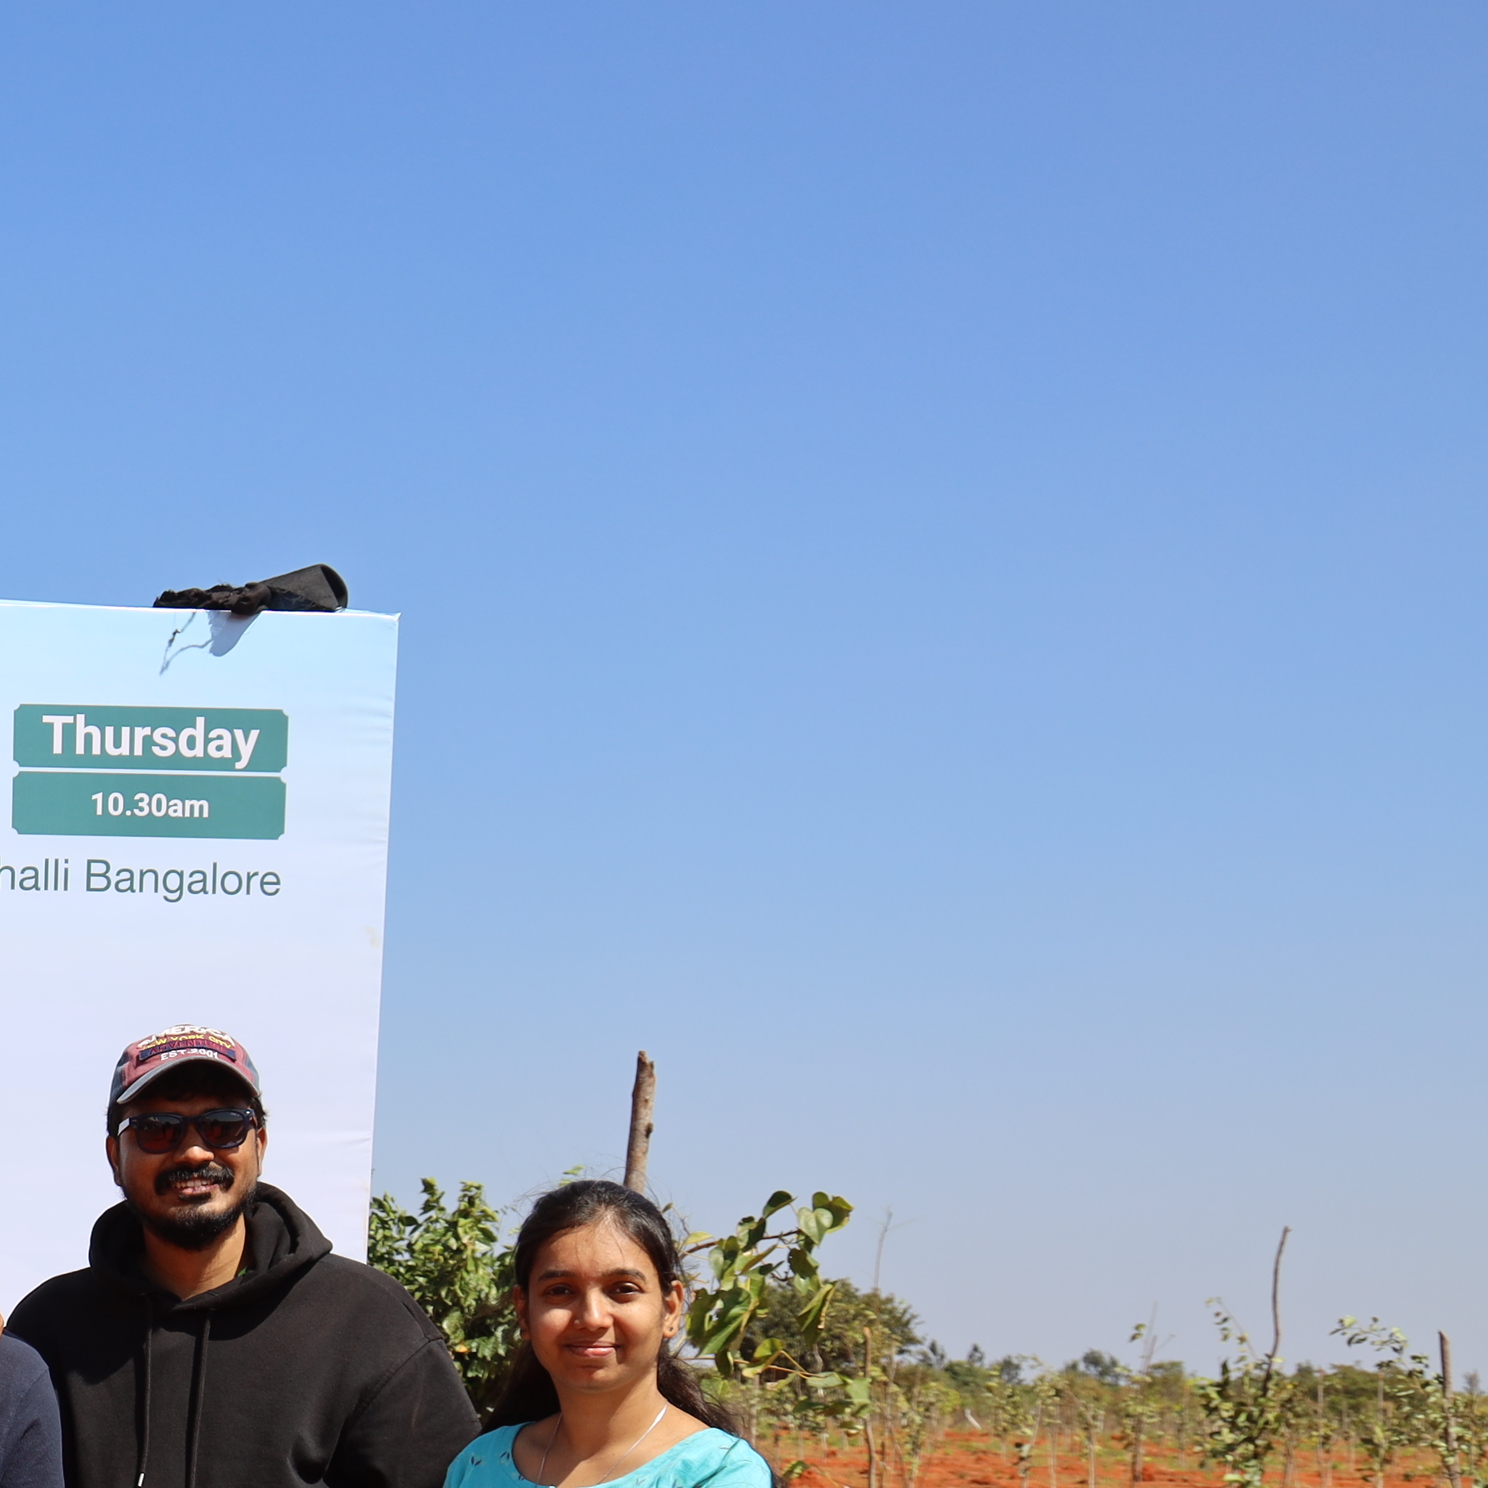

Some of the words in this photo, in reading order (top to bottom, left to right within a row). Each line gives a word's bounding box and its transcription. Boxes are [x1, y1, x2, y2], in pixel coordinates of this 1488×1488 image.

[42, 714, 261, 769] Thursday
[91, 791, 209, 818] 10.30am
[85, 858, 282, 904] Bangalore
